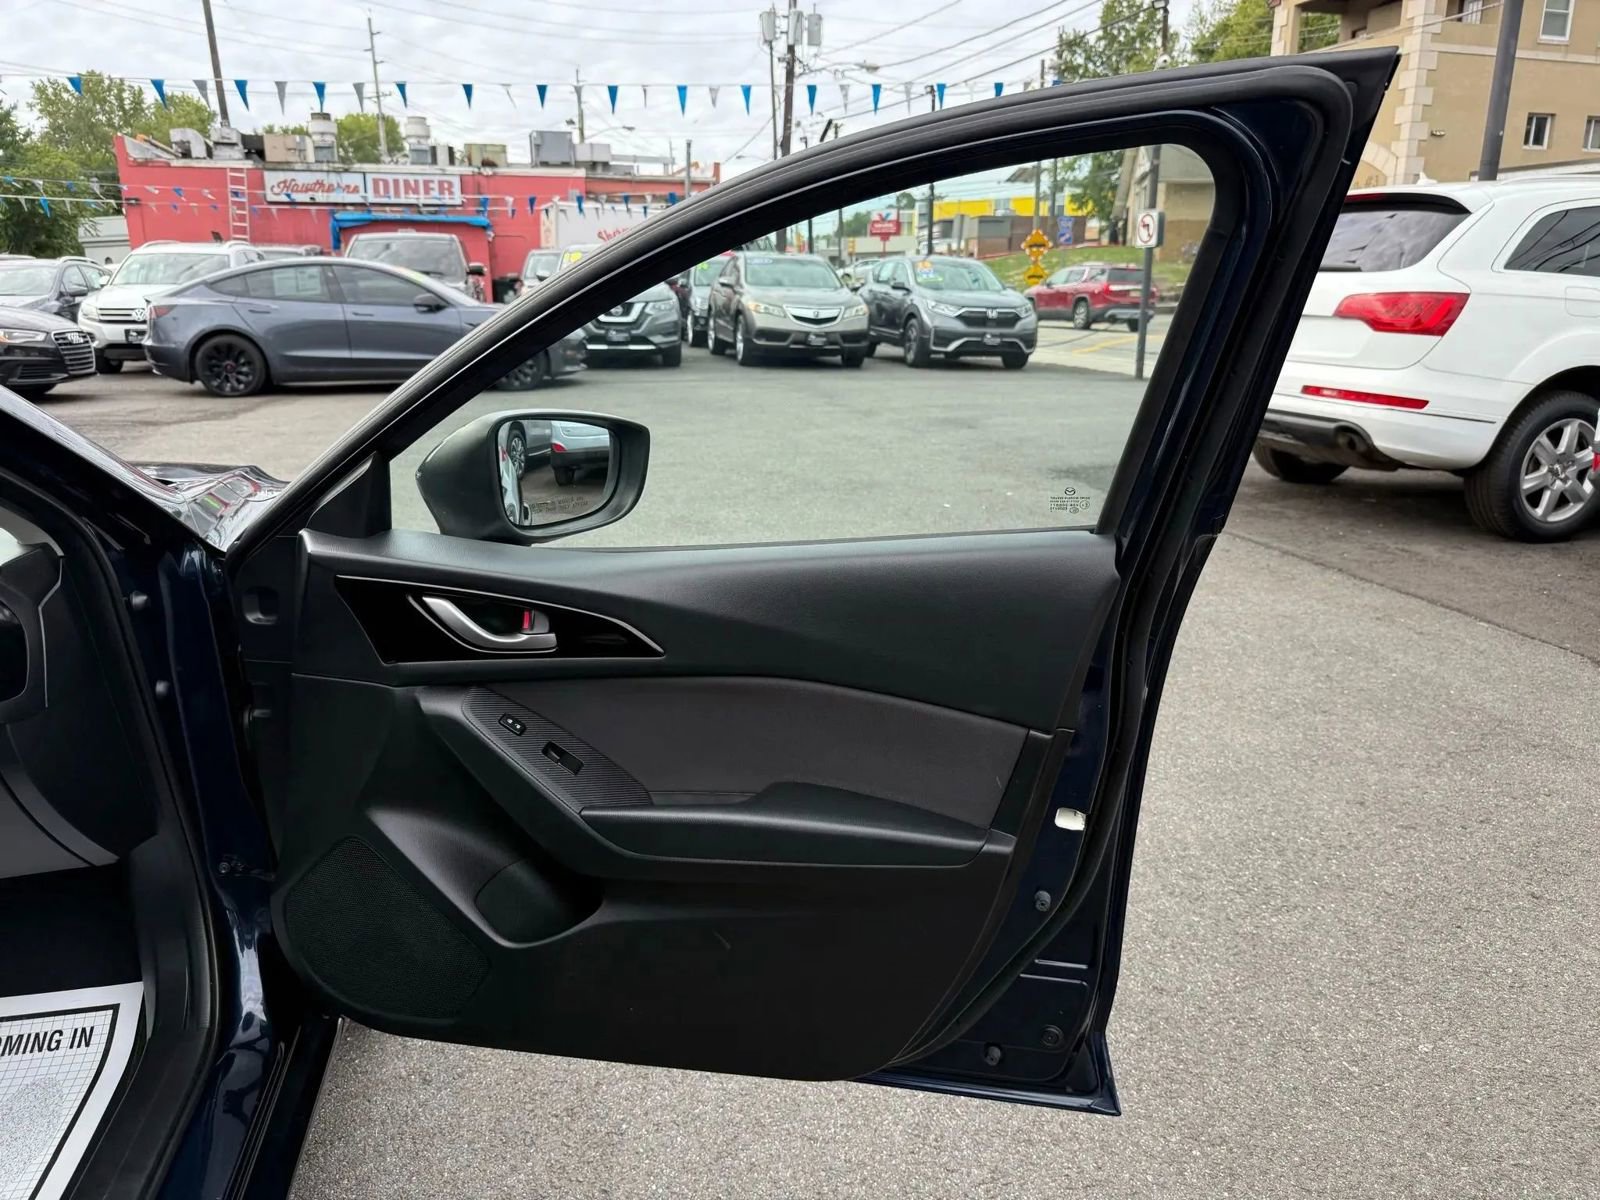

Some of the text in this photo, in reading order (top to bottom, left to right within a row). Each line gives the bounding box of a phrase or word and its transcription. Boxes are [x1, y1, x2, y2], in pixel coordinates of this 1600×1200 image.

[372, 178, 455, 199] DINER
[0, 1026, 94, 1057] MING IN
